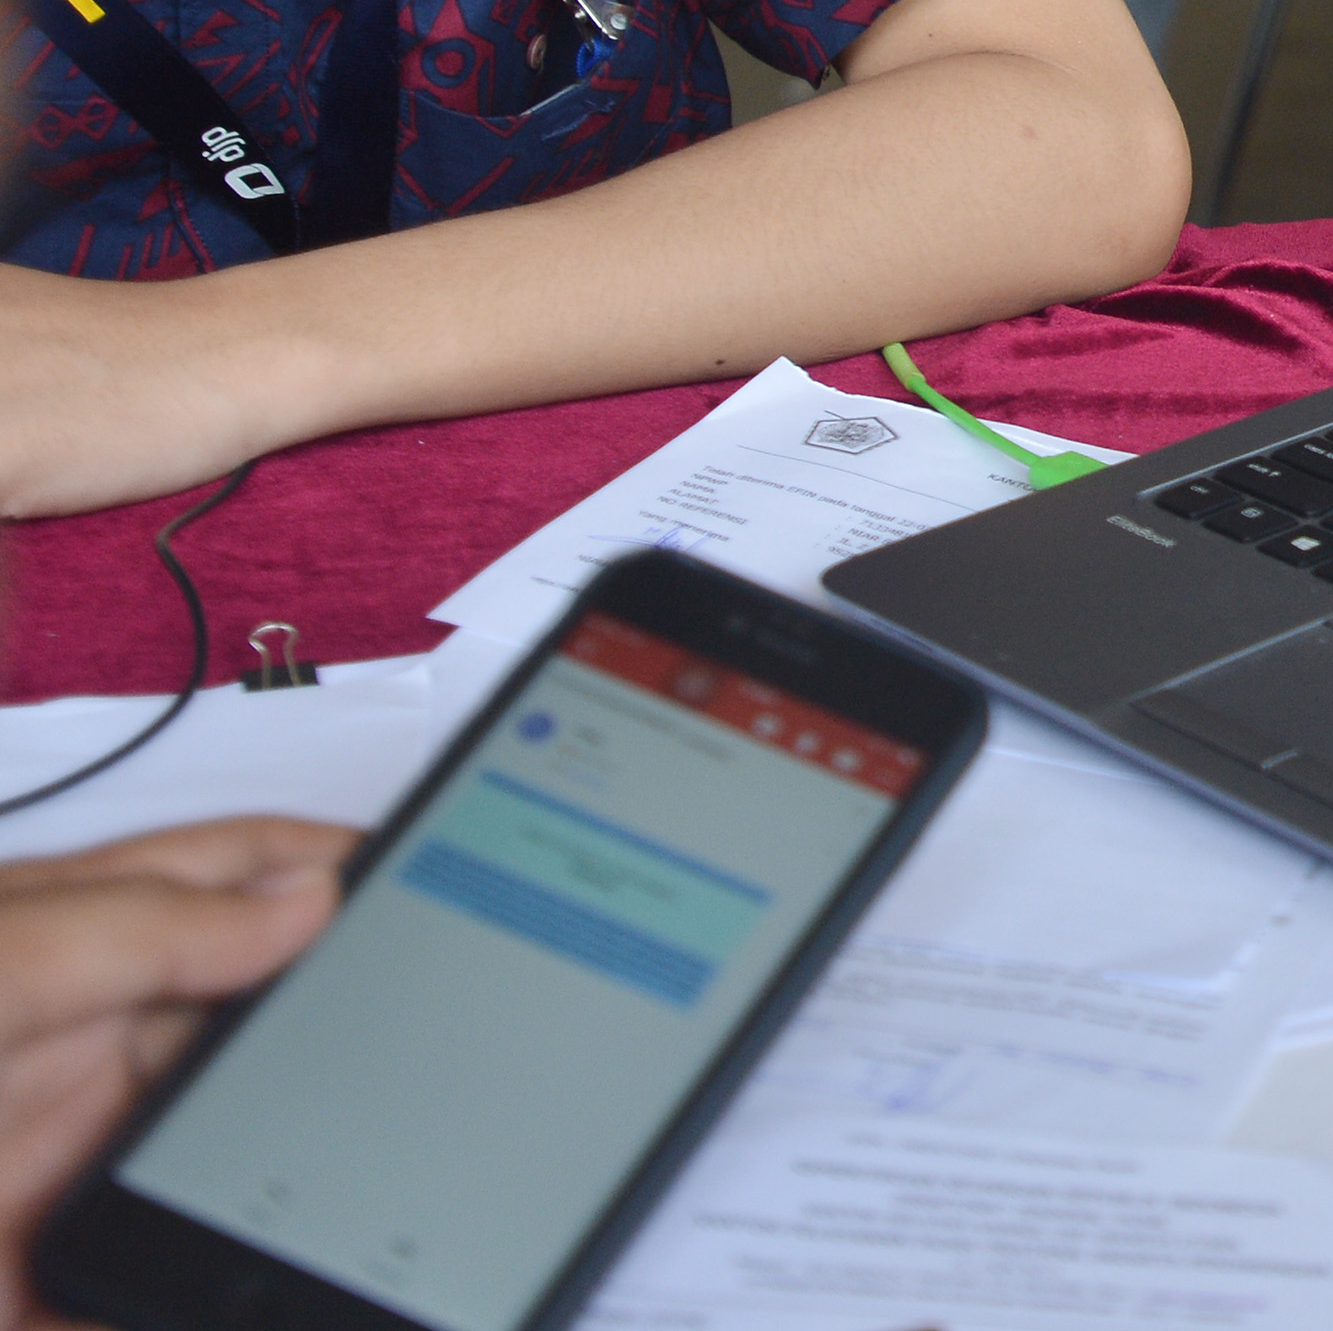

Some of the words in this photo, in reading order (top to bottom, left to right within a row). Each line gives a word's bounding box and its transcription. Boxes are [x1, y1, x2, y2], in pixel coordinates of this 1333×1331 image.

[201, 126, 246, 162] djp
[680, 480, 716, 495] NAMA
[690, 473, 728, 487] NPWP
[703, 465, 734, 479] Telah
[736, 474, 784, 491] diterima
[786, 485, 817, 499] EFIN
[817, 495, 848, 508] pada
[850, 504, 895, 523] tanggal
[656, 496, 677, 506] NO
[680, 501, 748, 527] REFERENSI
[668, 488, 719, 506] ALAMAT
[638, 510, 668, 525] Yang
[670, 519, 731, 543] menerima
